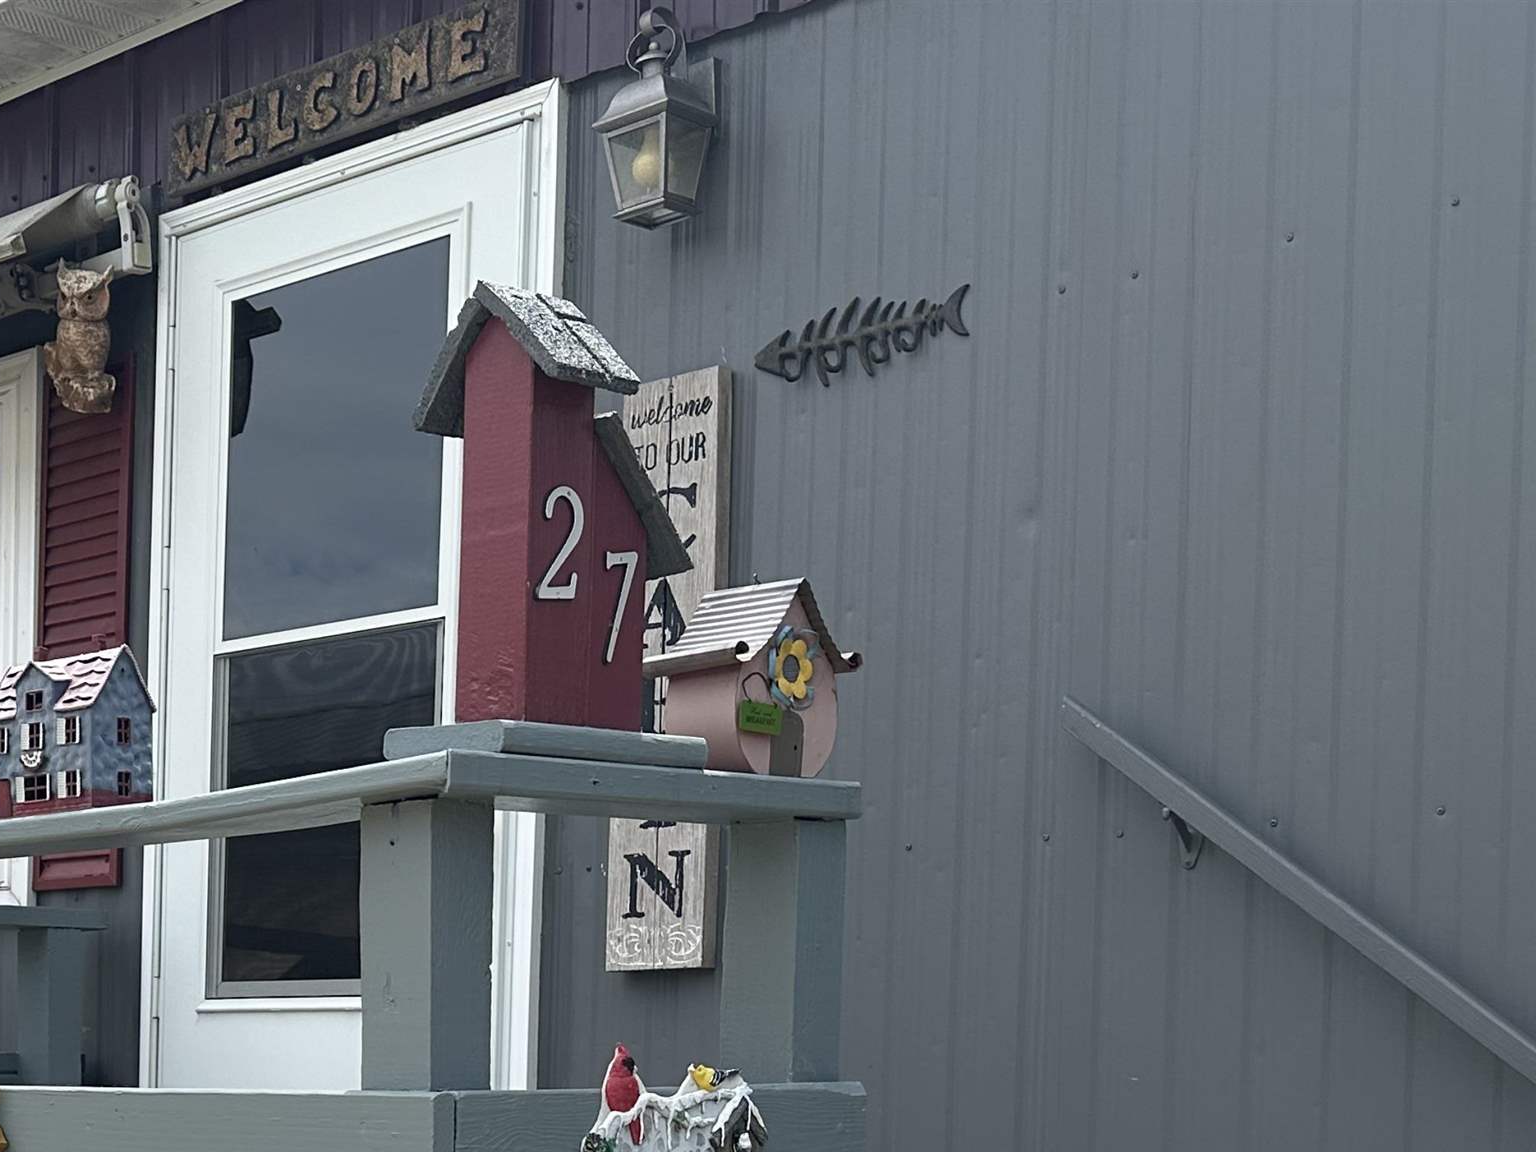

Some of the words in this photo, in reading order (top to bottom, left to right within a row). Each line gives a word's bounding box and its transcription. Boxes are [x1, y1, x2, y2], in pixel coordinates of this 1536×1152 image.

[174, 7, 488, 181] WELCOME
[631, 395, 712, 431] welcome
[666, 431, 707, 466] OUR
